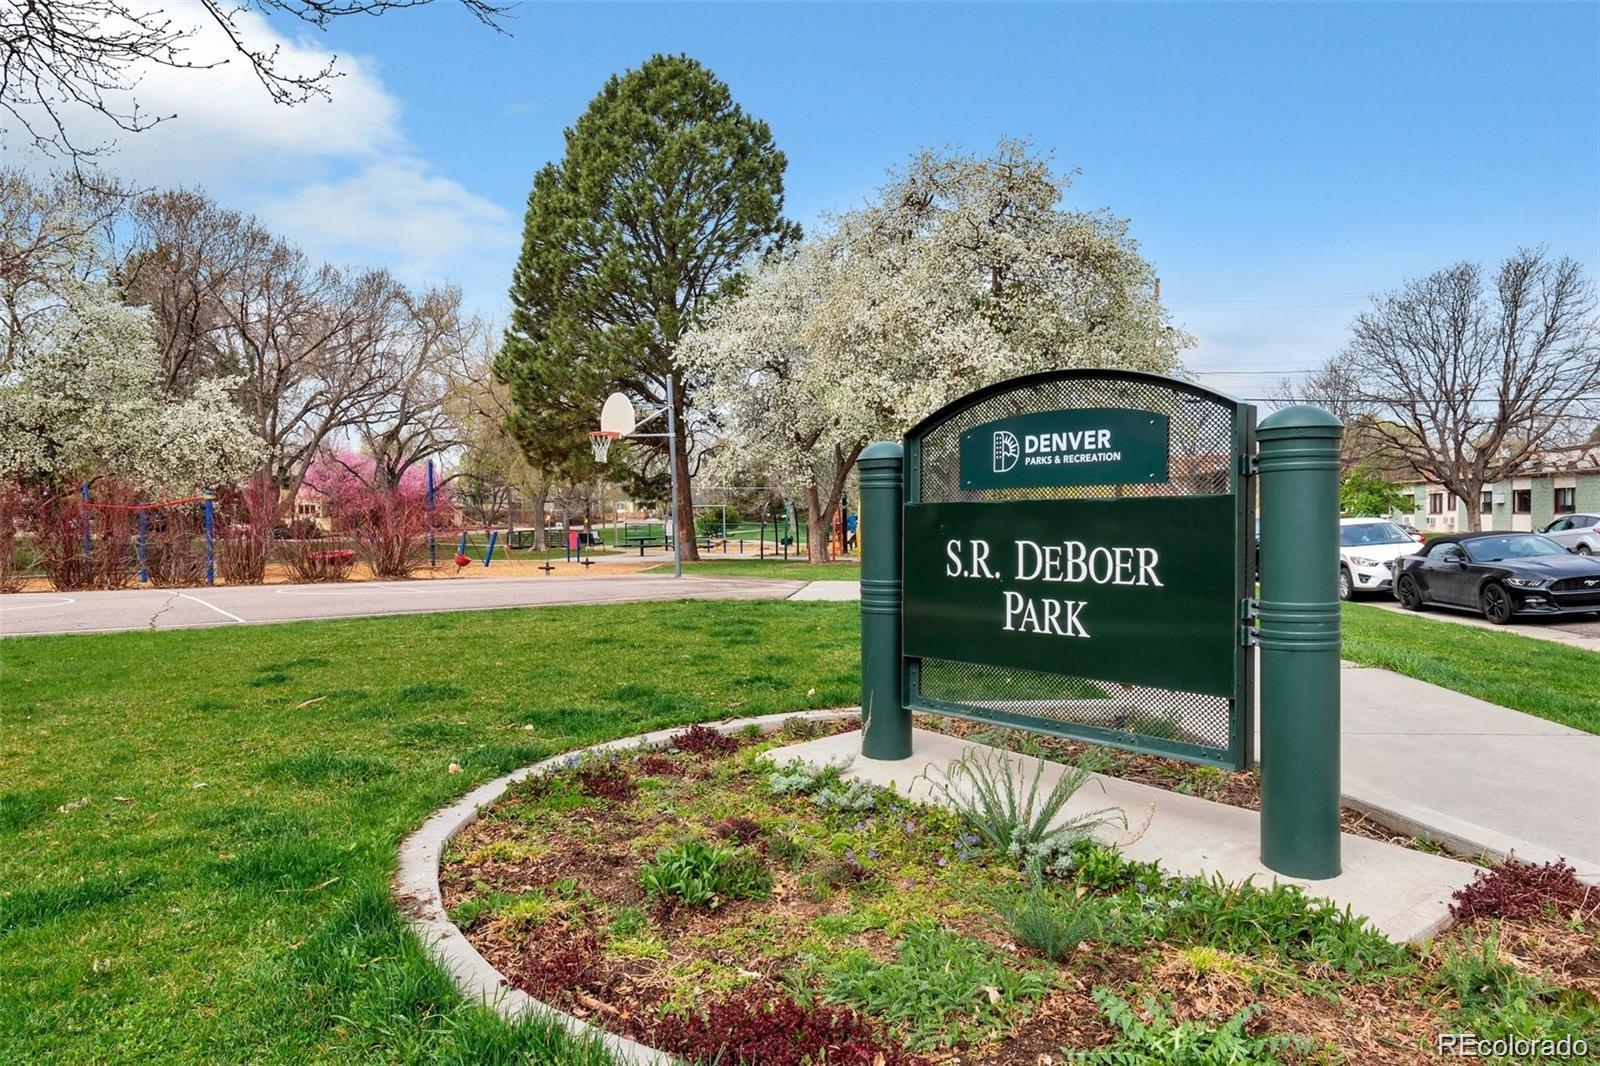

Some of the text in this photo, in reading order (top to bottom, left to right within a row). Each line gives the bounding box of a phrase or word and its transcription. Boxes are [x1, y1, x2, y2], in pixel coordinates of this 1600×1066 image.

[1025, 429, 1111, 453] DENVER
[1025, 451, 1121, 466] PARKS & RECREATION
[946, 539, 1000, 579] S.R.
[1002, 591, 1090, 638] PARK
